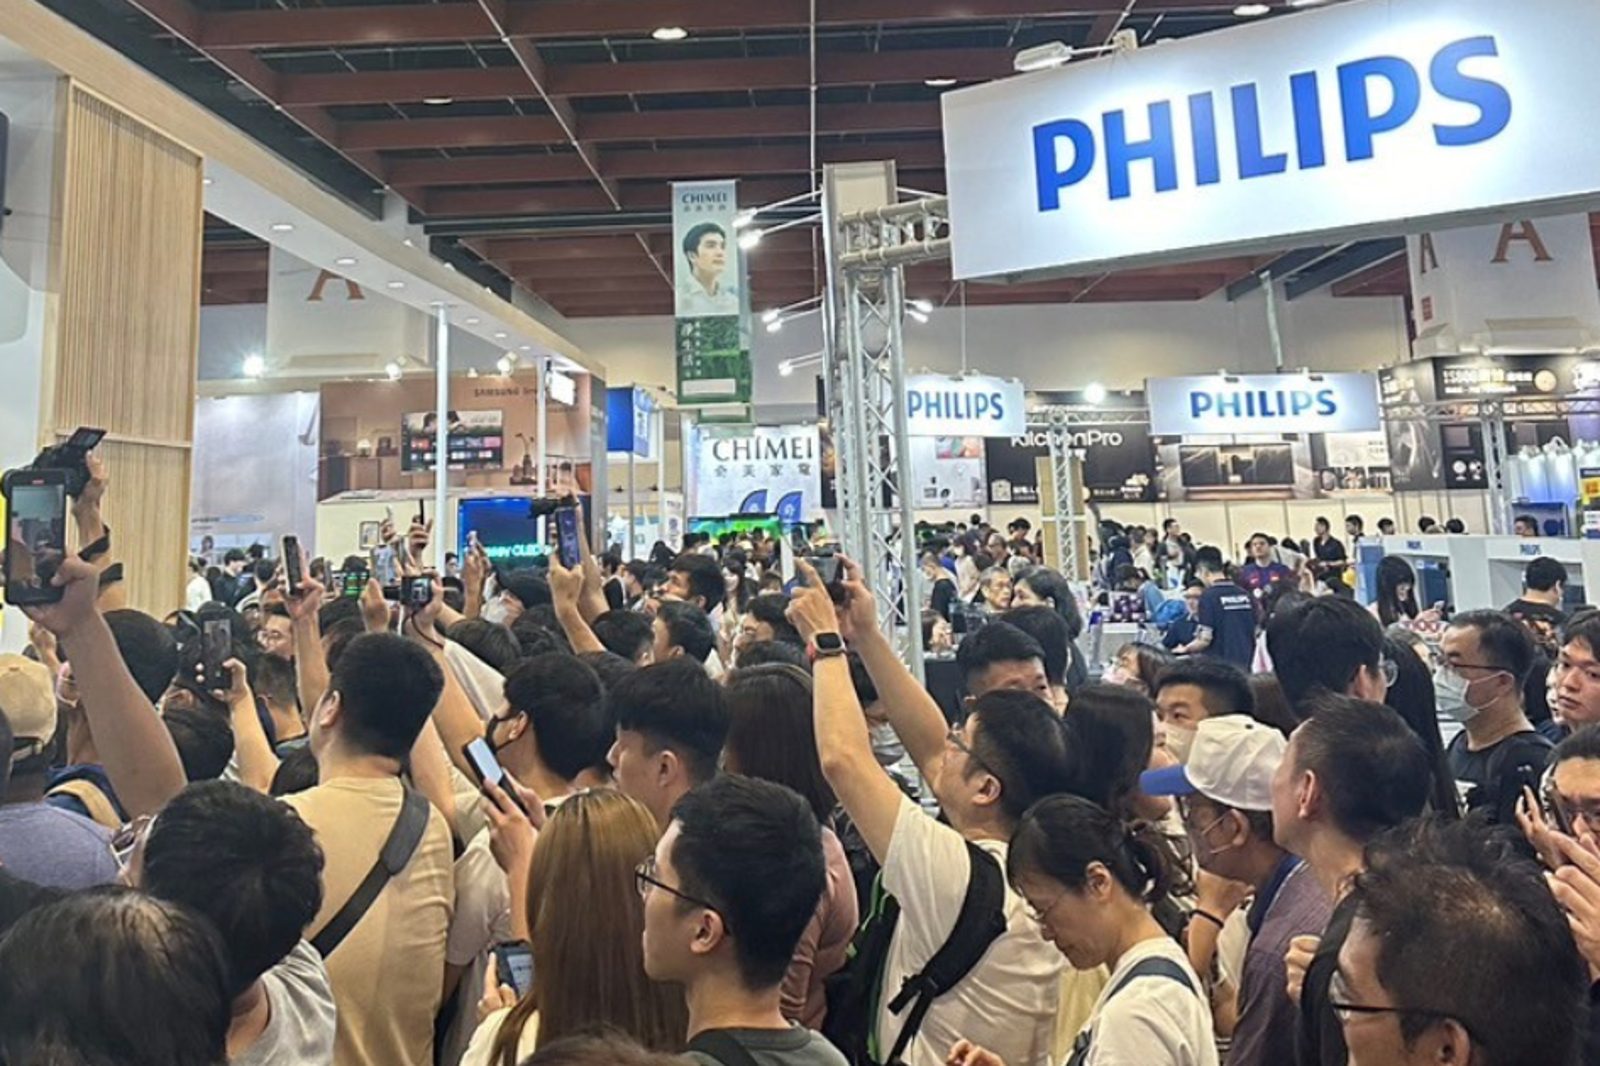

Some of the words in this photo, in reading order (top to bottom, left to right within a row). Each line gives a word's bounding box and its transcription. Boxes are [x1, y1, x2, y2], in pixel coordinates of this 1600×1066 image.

[1032, 35, 1512, 212] PHILIPS
[681, 192, 728, 204] CHIMEI
[1490, 219, 1554, 263] A
[474, 387, 519, 397] SAMSUNG
[907, 390, 1004, 420] PHILIPS
[1190, 389, 1338, 419] PHILIPS
[712, 436, 813, 461] CHIMEI
